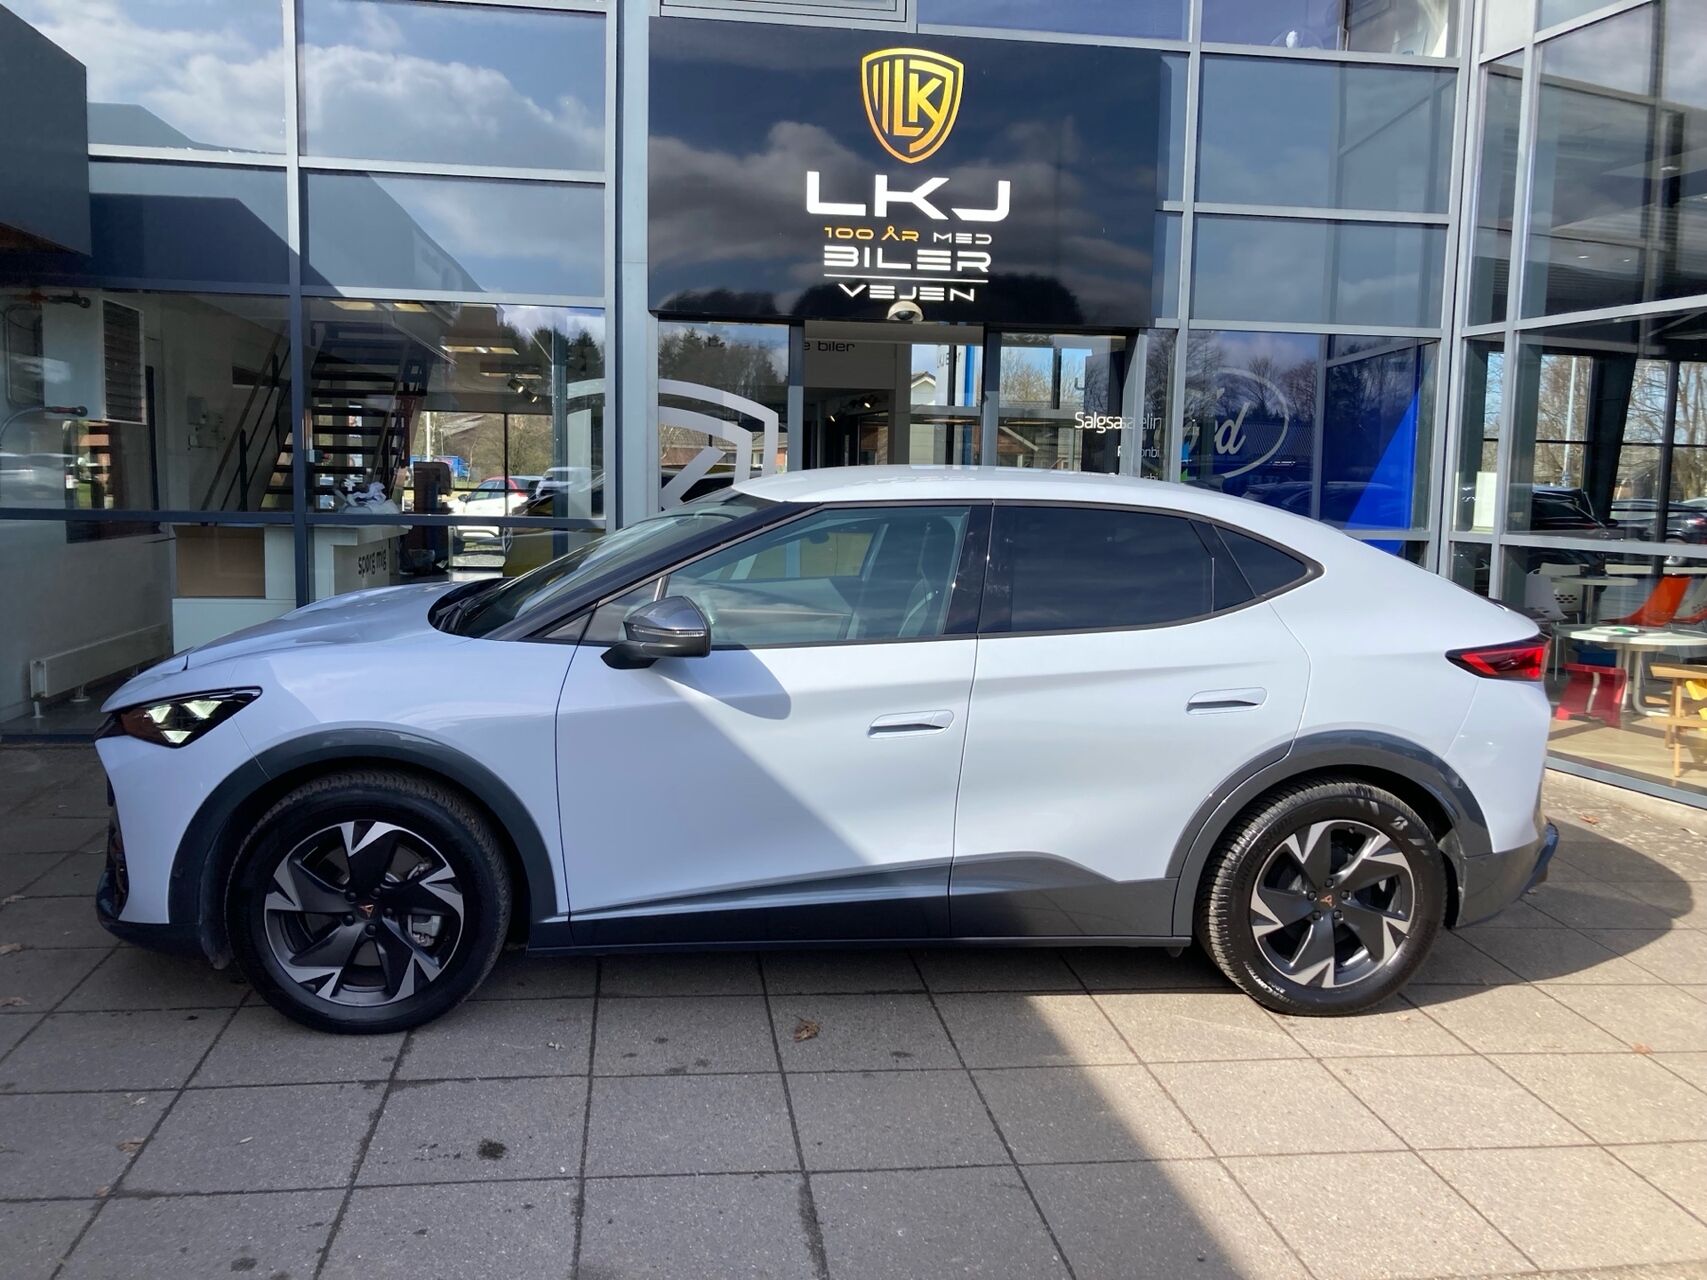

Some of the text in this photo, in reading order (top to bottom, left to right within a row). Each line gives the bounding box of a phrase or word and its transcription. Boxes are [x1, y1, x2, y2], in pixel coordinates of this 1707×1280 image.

[806, 171, 1011, 222] LKJ
[824, 225, 992, 245] 100 ÅR MED
[823, 245, 992, 273] BILER
[838, 283, 975, 302] VEJEN
[817, 340, 856, 352] biler
